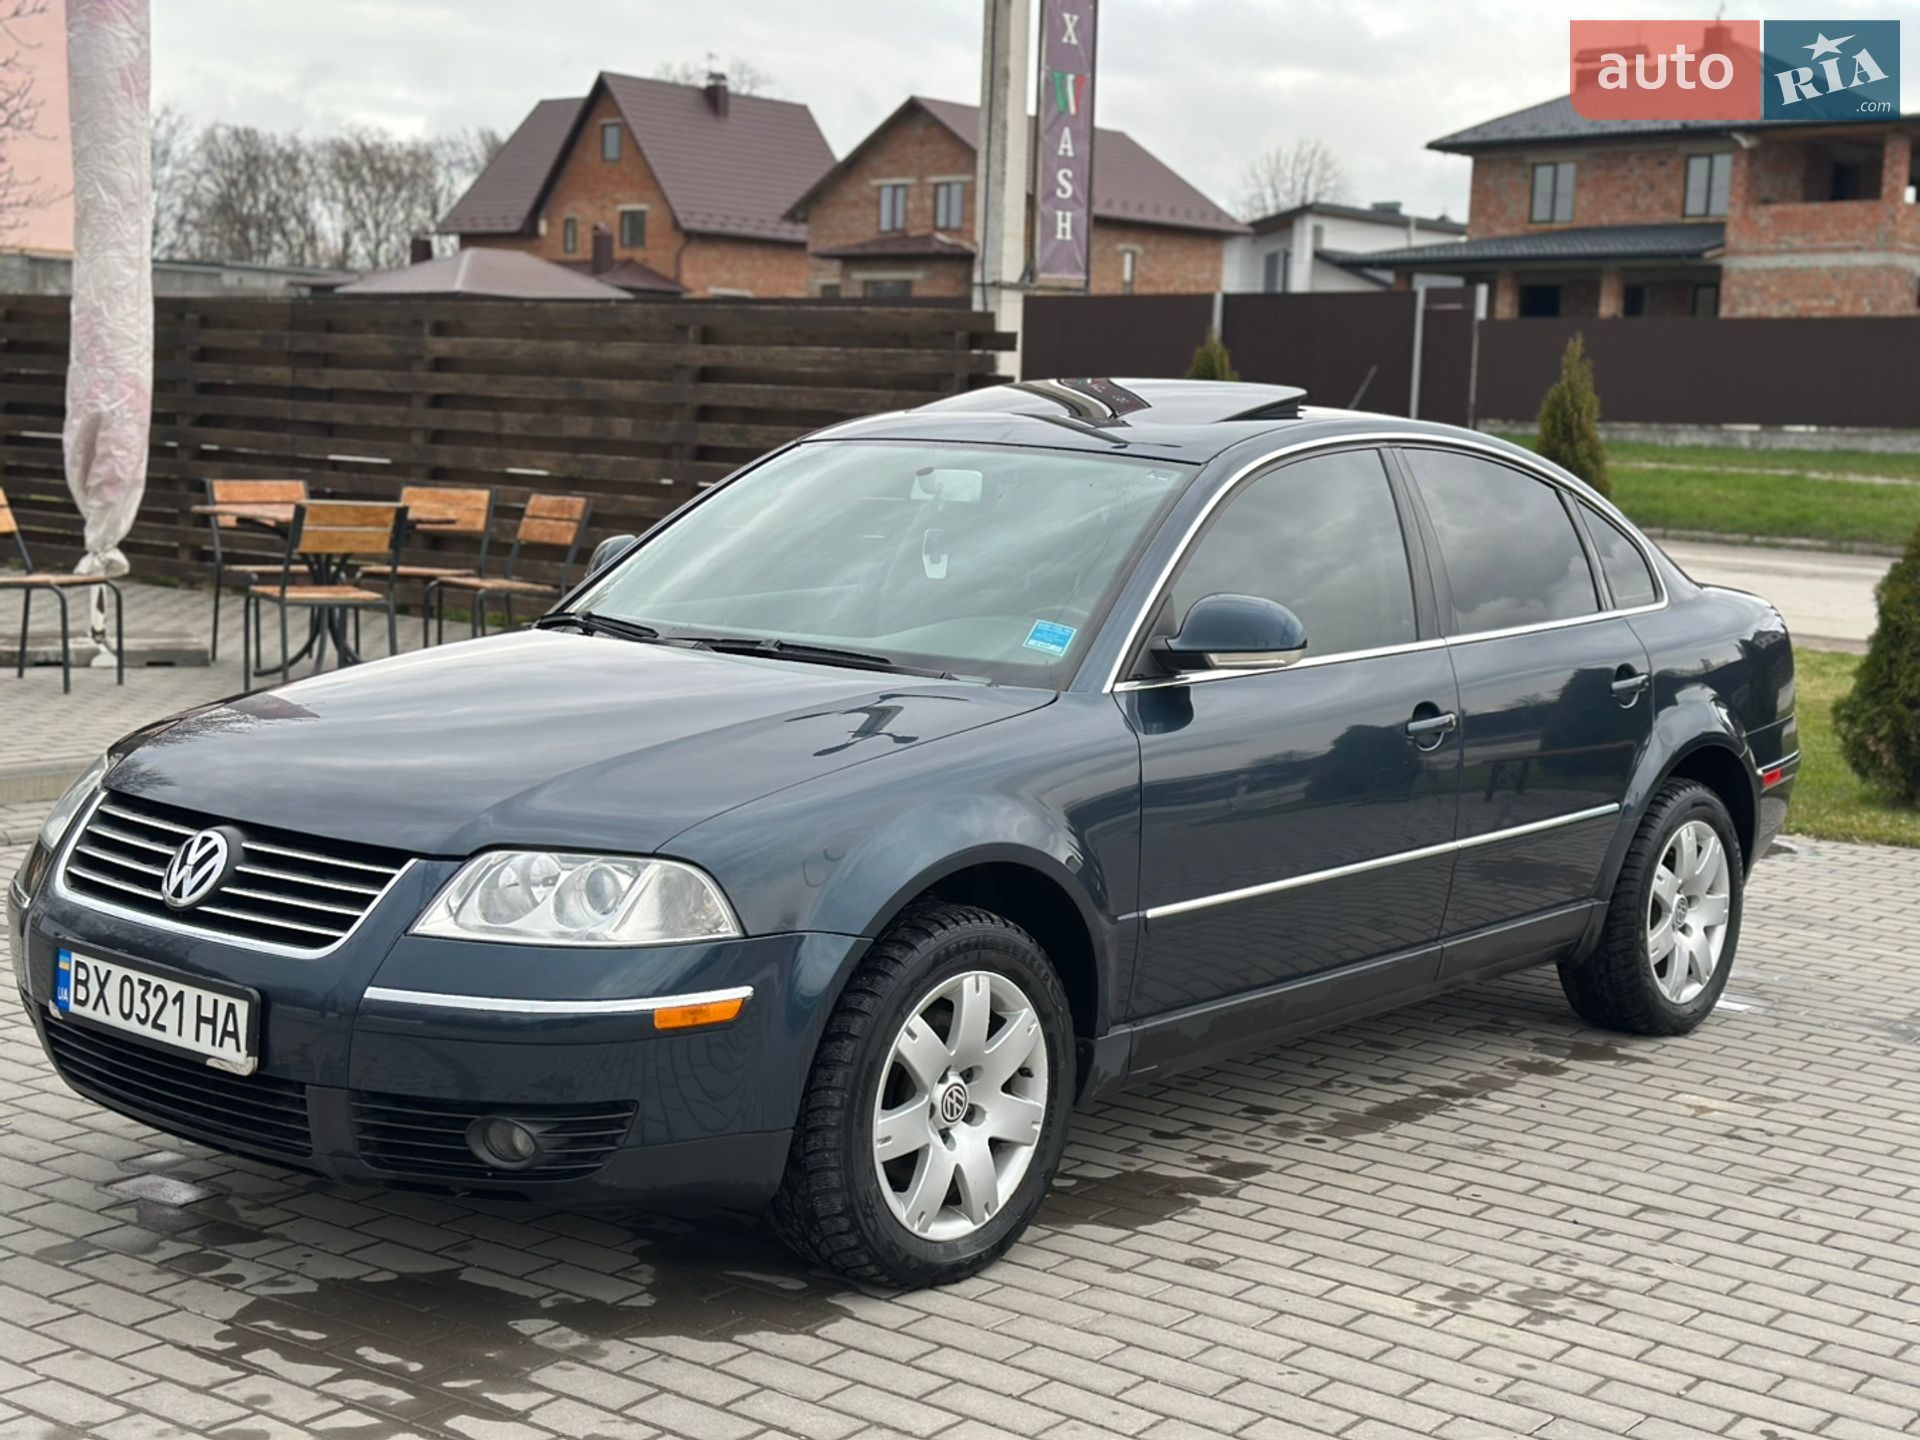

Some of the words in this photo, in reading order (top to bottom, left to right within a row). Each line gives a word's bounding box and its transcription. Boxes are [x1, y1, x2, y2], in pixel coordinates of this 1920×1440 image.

[73, 959, 112, 1016] BX
[118, 974, 185, 1037] 0321
[195, 994, 241, 1053] HA
